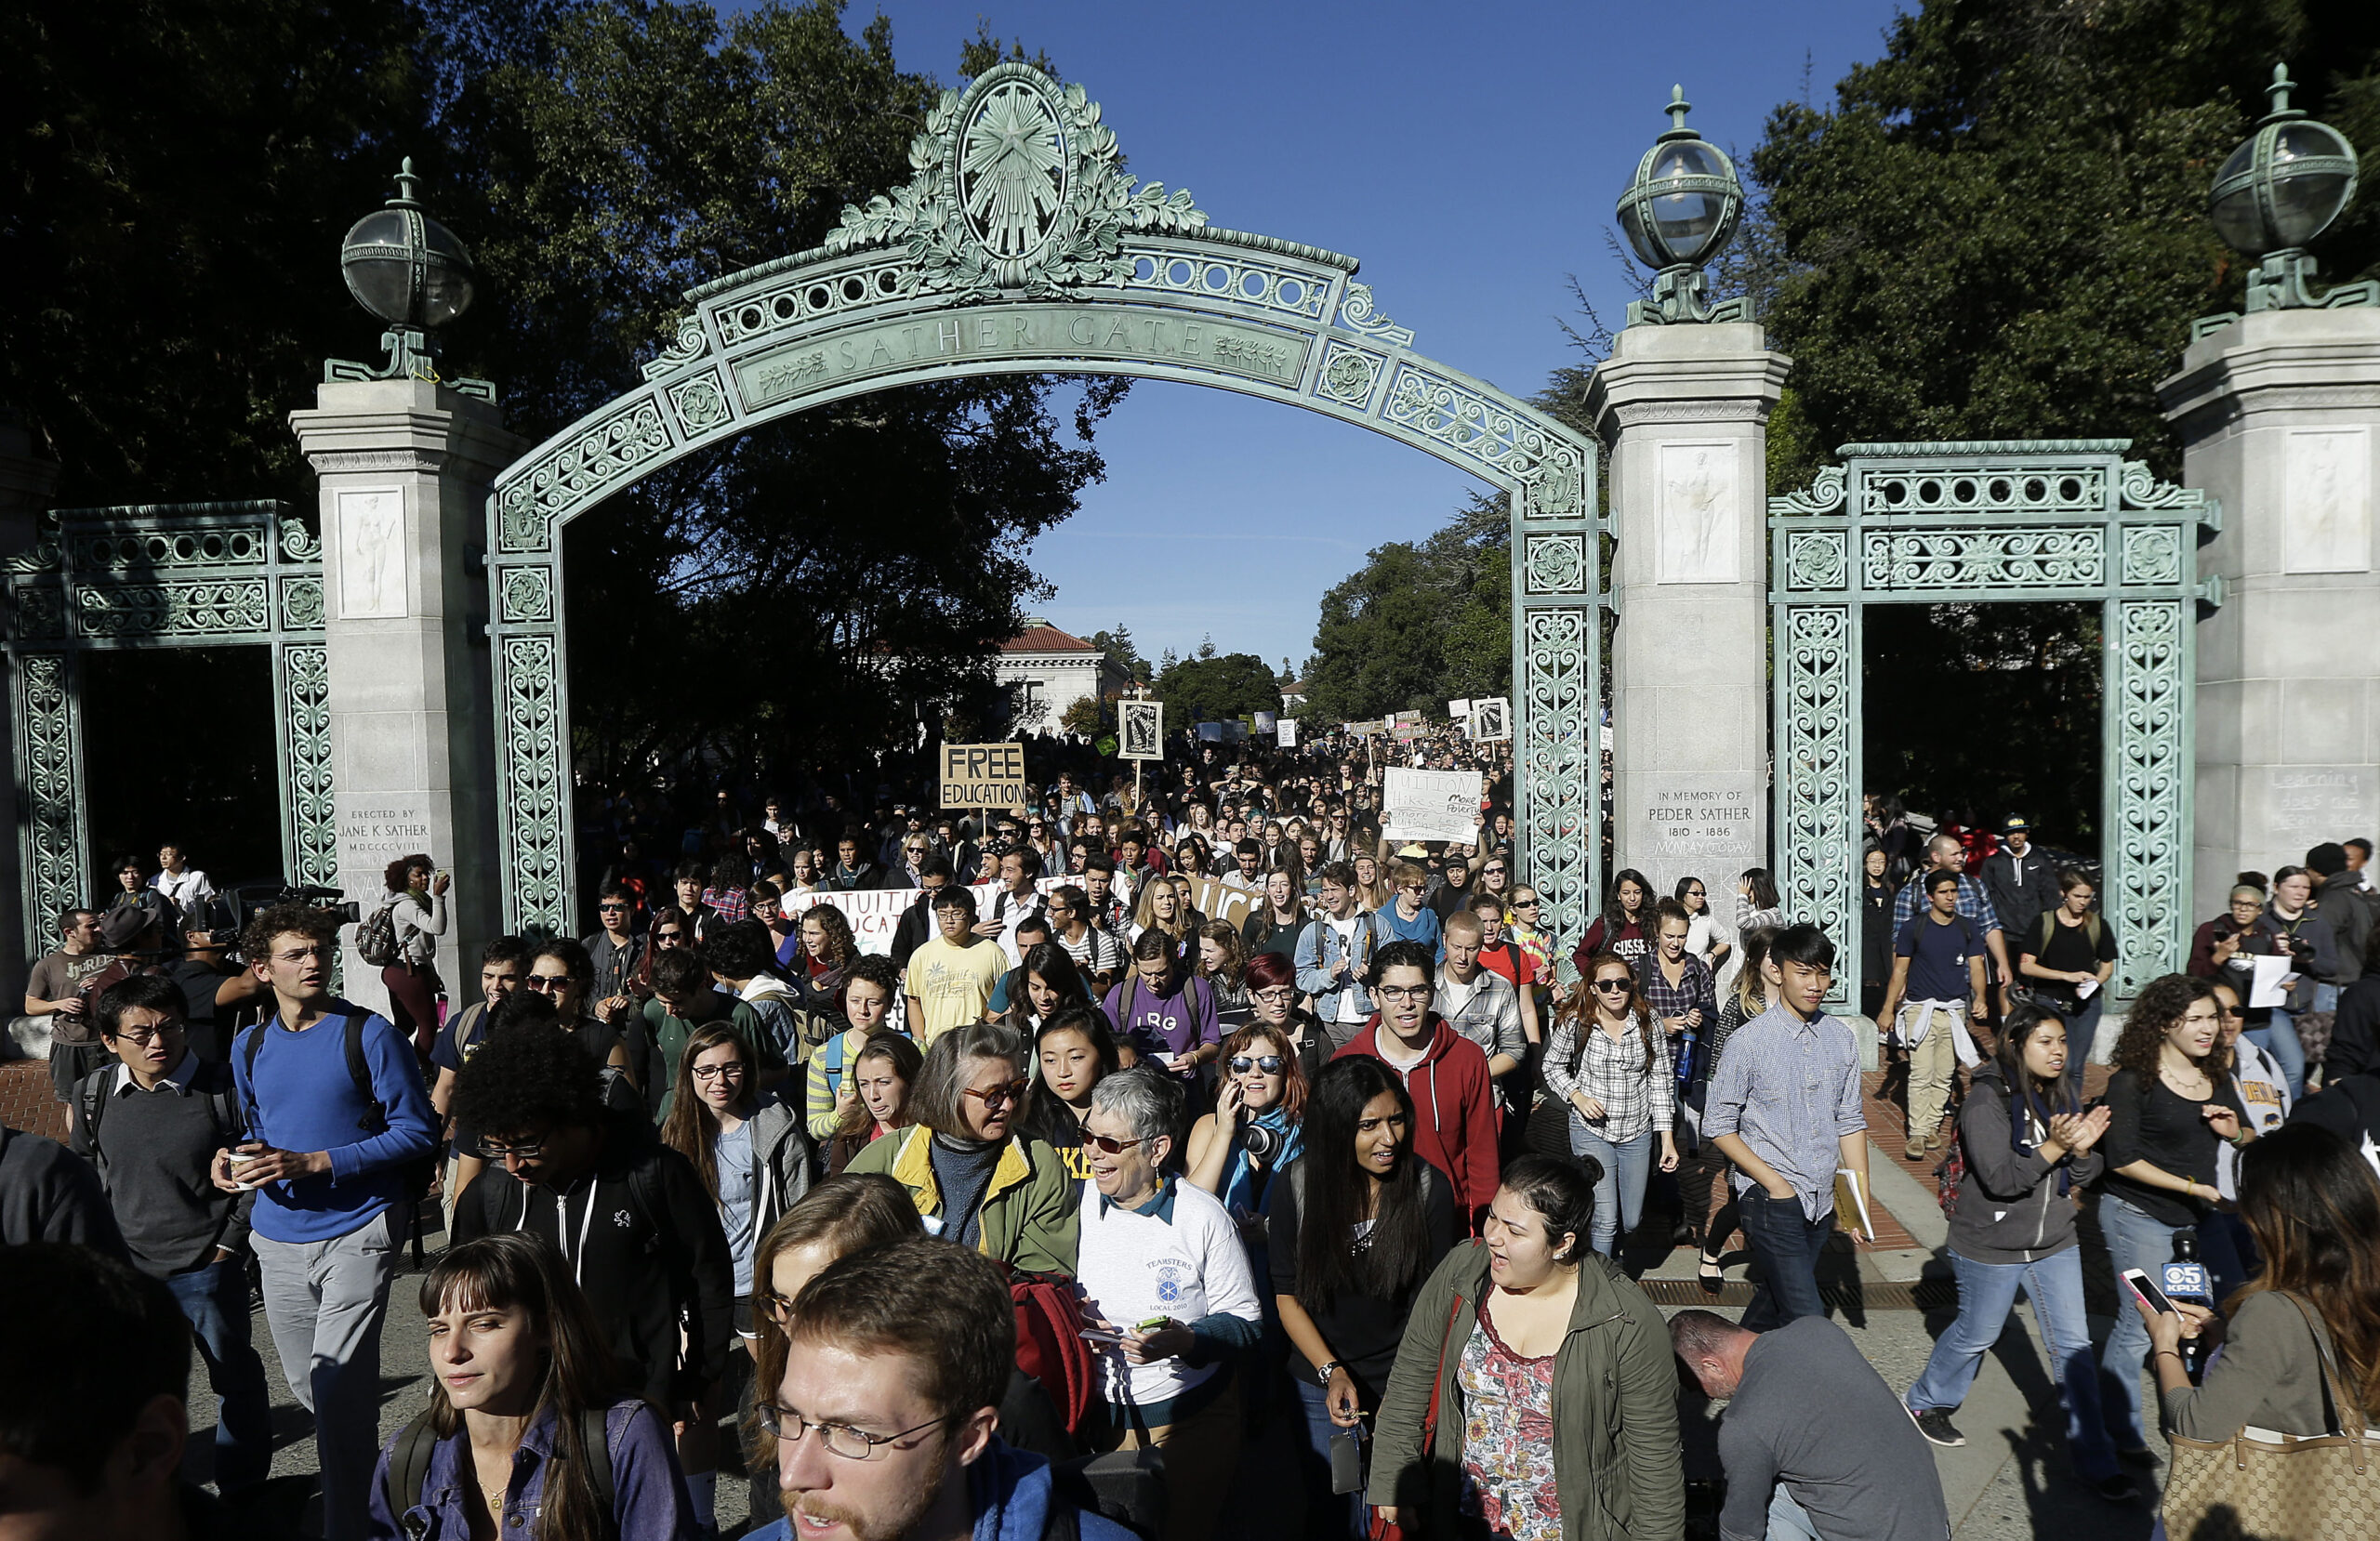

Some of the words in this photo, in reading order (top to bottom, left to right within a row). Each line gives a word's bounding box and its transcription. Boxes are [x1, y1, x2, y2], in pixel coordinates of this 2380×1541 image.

[840, 316, 1035, 371] SATHER
[1068, 314, 1202, 357] GATE
[947, 748, 1022, 779] FREE
[1387, 771, 1474, 794] TUITION
[943, 784, 1025, 804] EDUCATION
[1673, 792, 1722, 800] MEMORY
[1726, 792, 1742, 800] OF
[351, 810, 396, 819] ERECTED
[403, 810, 415, 818] BY
[1649, 809, 1694, 821] PEDER
[1699, 808, 1752, 820] SATHER
[339, 825, 368, 837] JANE
[373, 825, 380, 836] K
[385, 824, 429, 836] SATHER
[1669, 827, 1690, 836] 1810
[1706, 827, 1730, 836] 1886
[1655, 840, 1704, 855] MONDAY
[1145, 1258, 1193, 1271] TEAMSTERS
[2184, 1266, 2202, 1284] 5
[2166, 1284, 2202, 1293] KPIX
[1173, 1302, 1188, 1311] 2010
